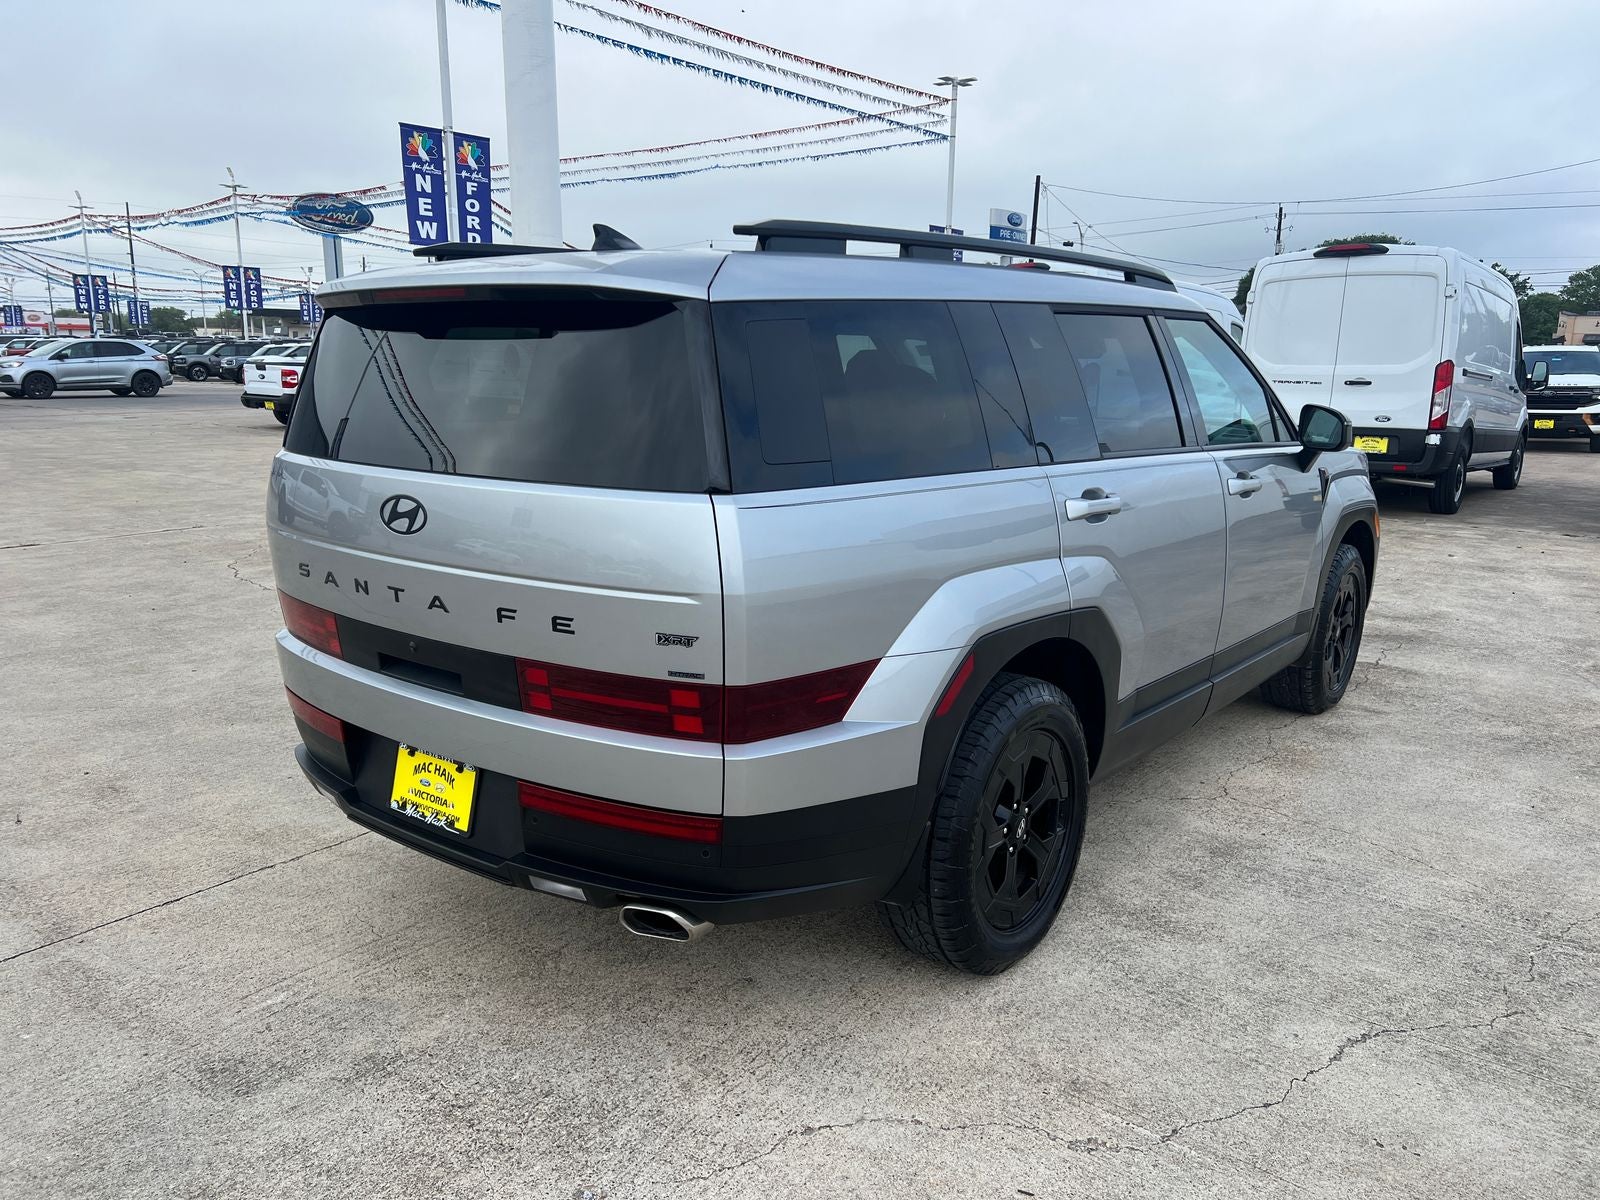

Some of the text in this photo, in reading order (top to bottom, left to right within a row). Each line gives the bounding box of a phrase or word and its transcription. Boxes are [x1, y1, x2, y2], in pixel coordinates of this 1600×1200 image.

[415, 173, 438, 240] NEW
[465, 181, 482, 243] FORD
[78, 288, 89, 310] NEW
[97, 289, 106, 310] FORD
[228, 282, 239, 307] NEW
[249, 283, 259, 308] FORD
[298, 562, 576, 635] SANTA FE
[412, 761, 456, 790] MAC HAIK
[413, 787, 448, 809] VICTORIA
[398, 804, 459, 834] Mac Haik
